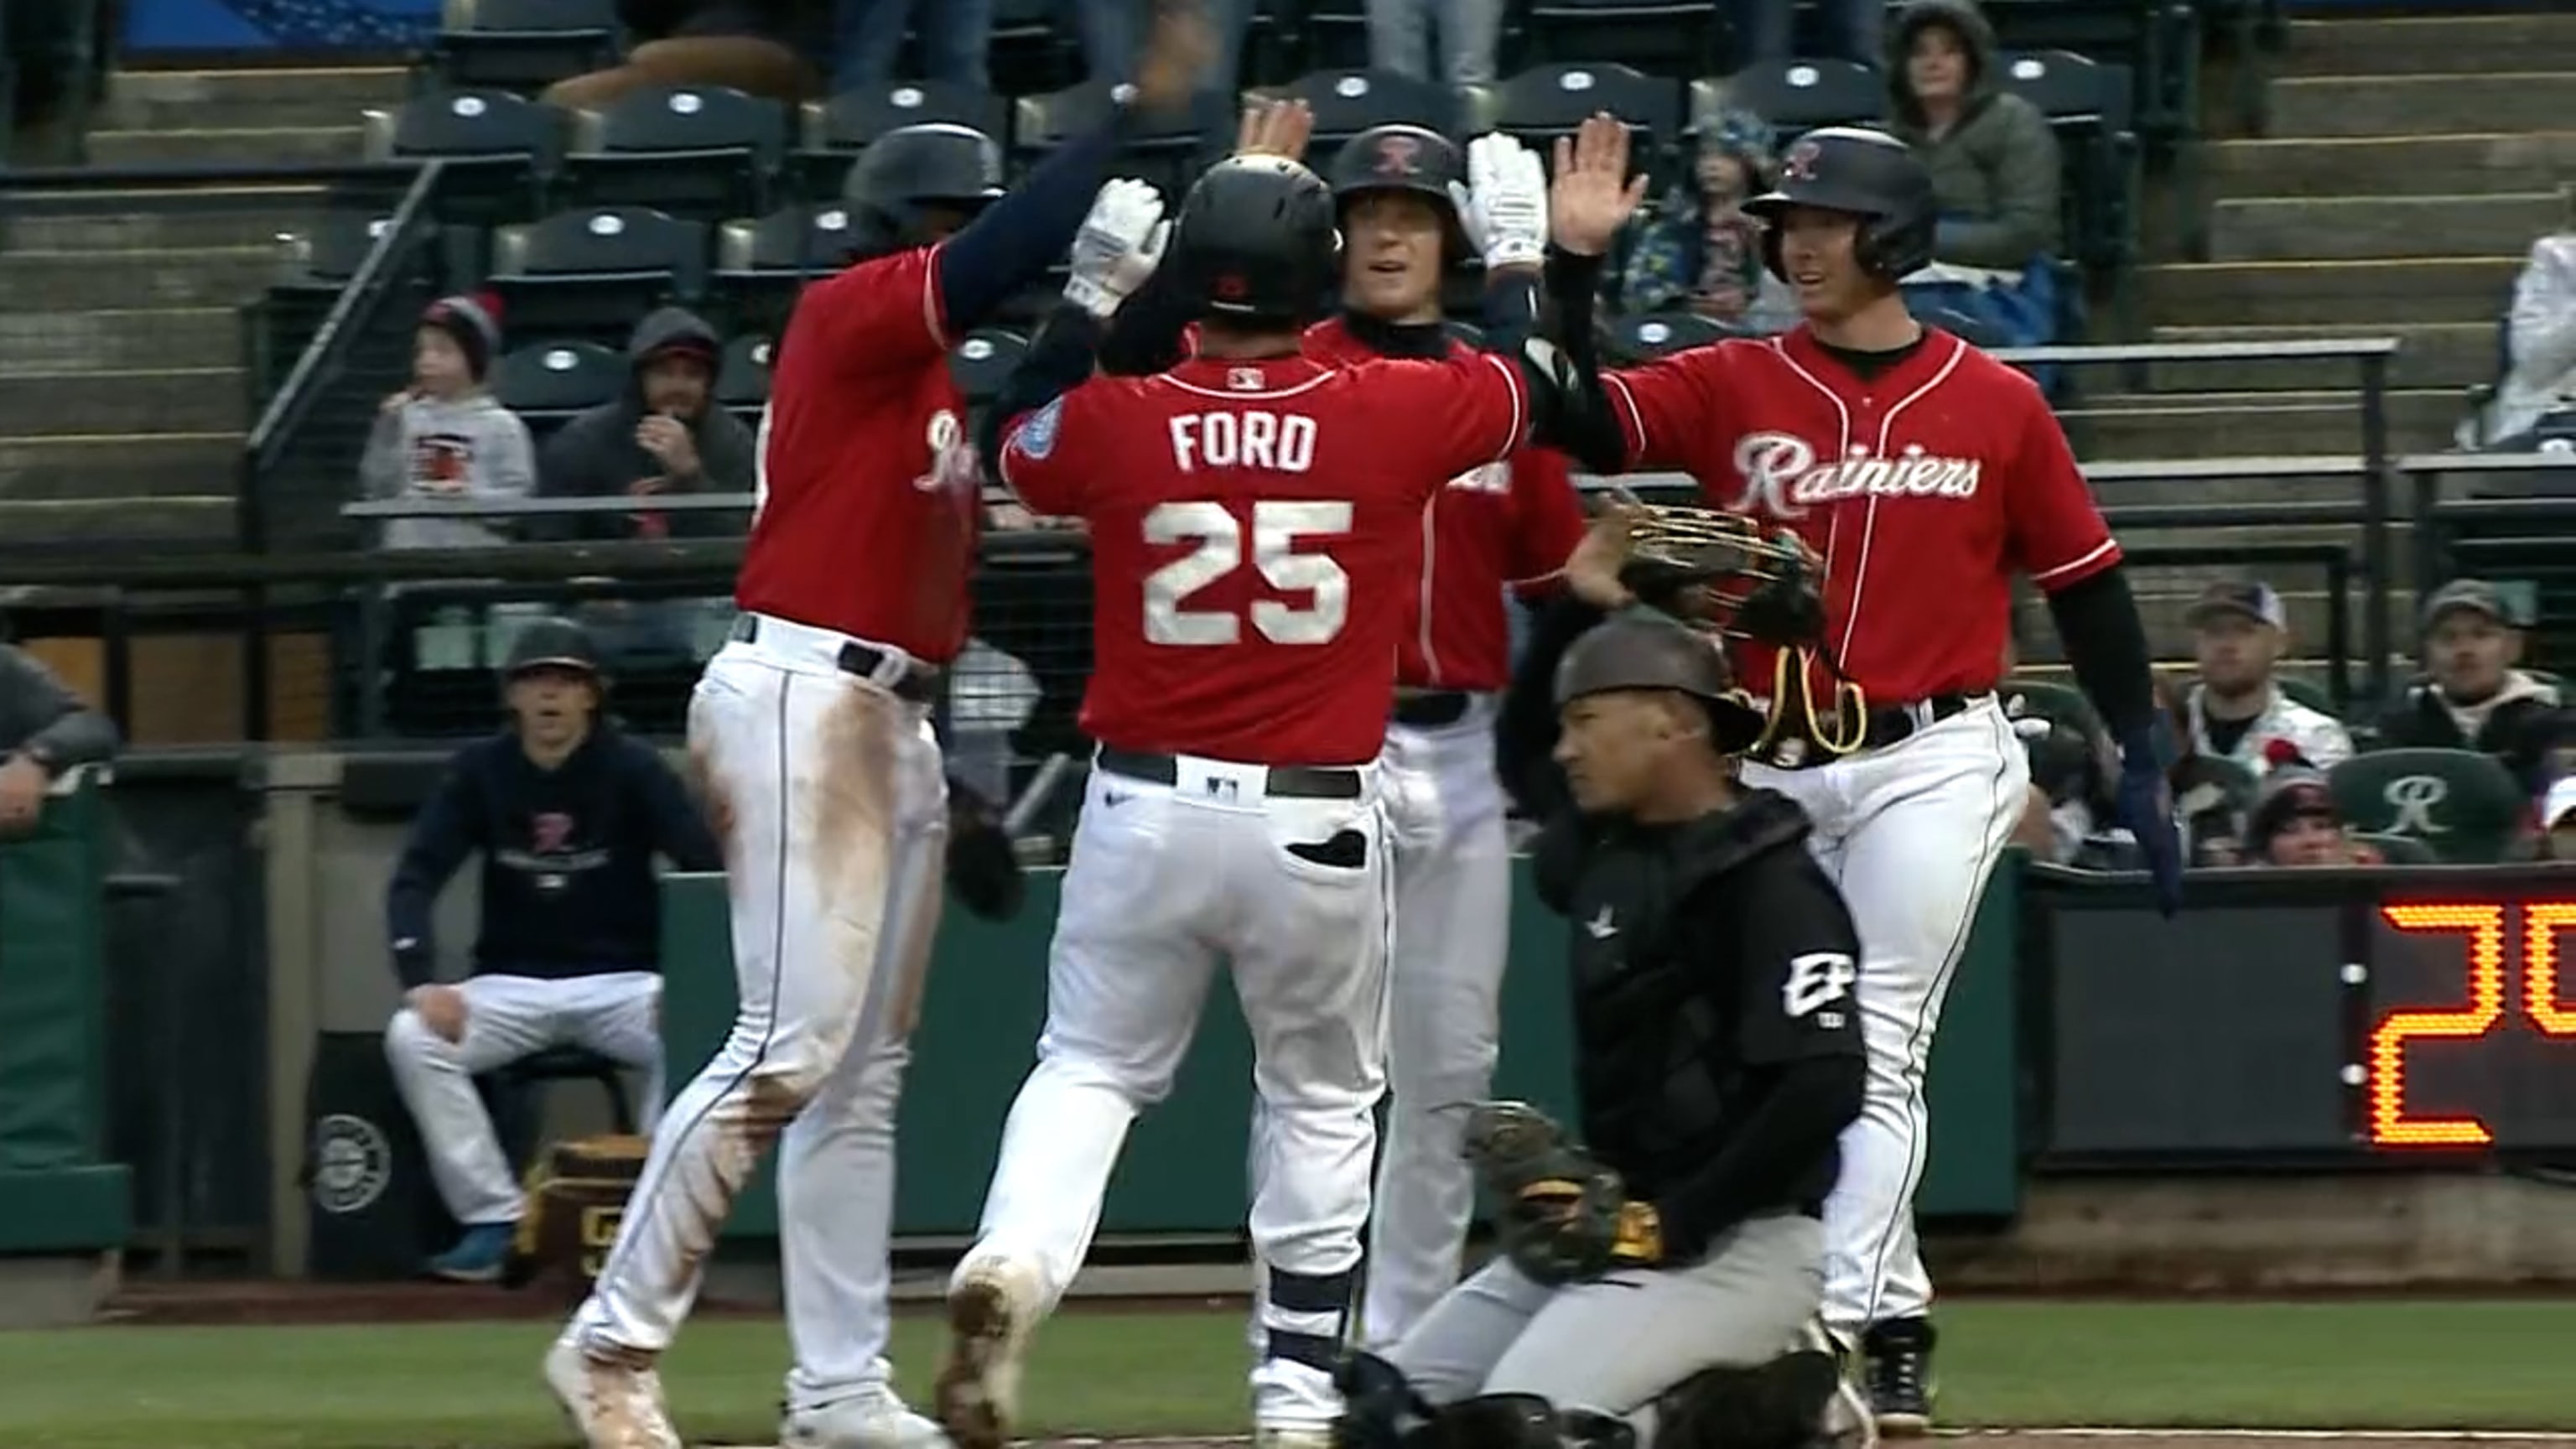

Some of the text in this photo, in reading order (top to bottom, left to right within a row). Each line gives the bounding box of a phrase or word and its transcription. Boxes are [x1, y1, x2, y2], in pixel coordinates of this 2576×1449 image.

[1169, 411, 1317, 471] FORD
[1726, 433, 1981, 518] Rainiers
[1142, 501, 1353, 644] 25
[2382, 775, 2454, 834] R
